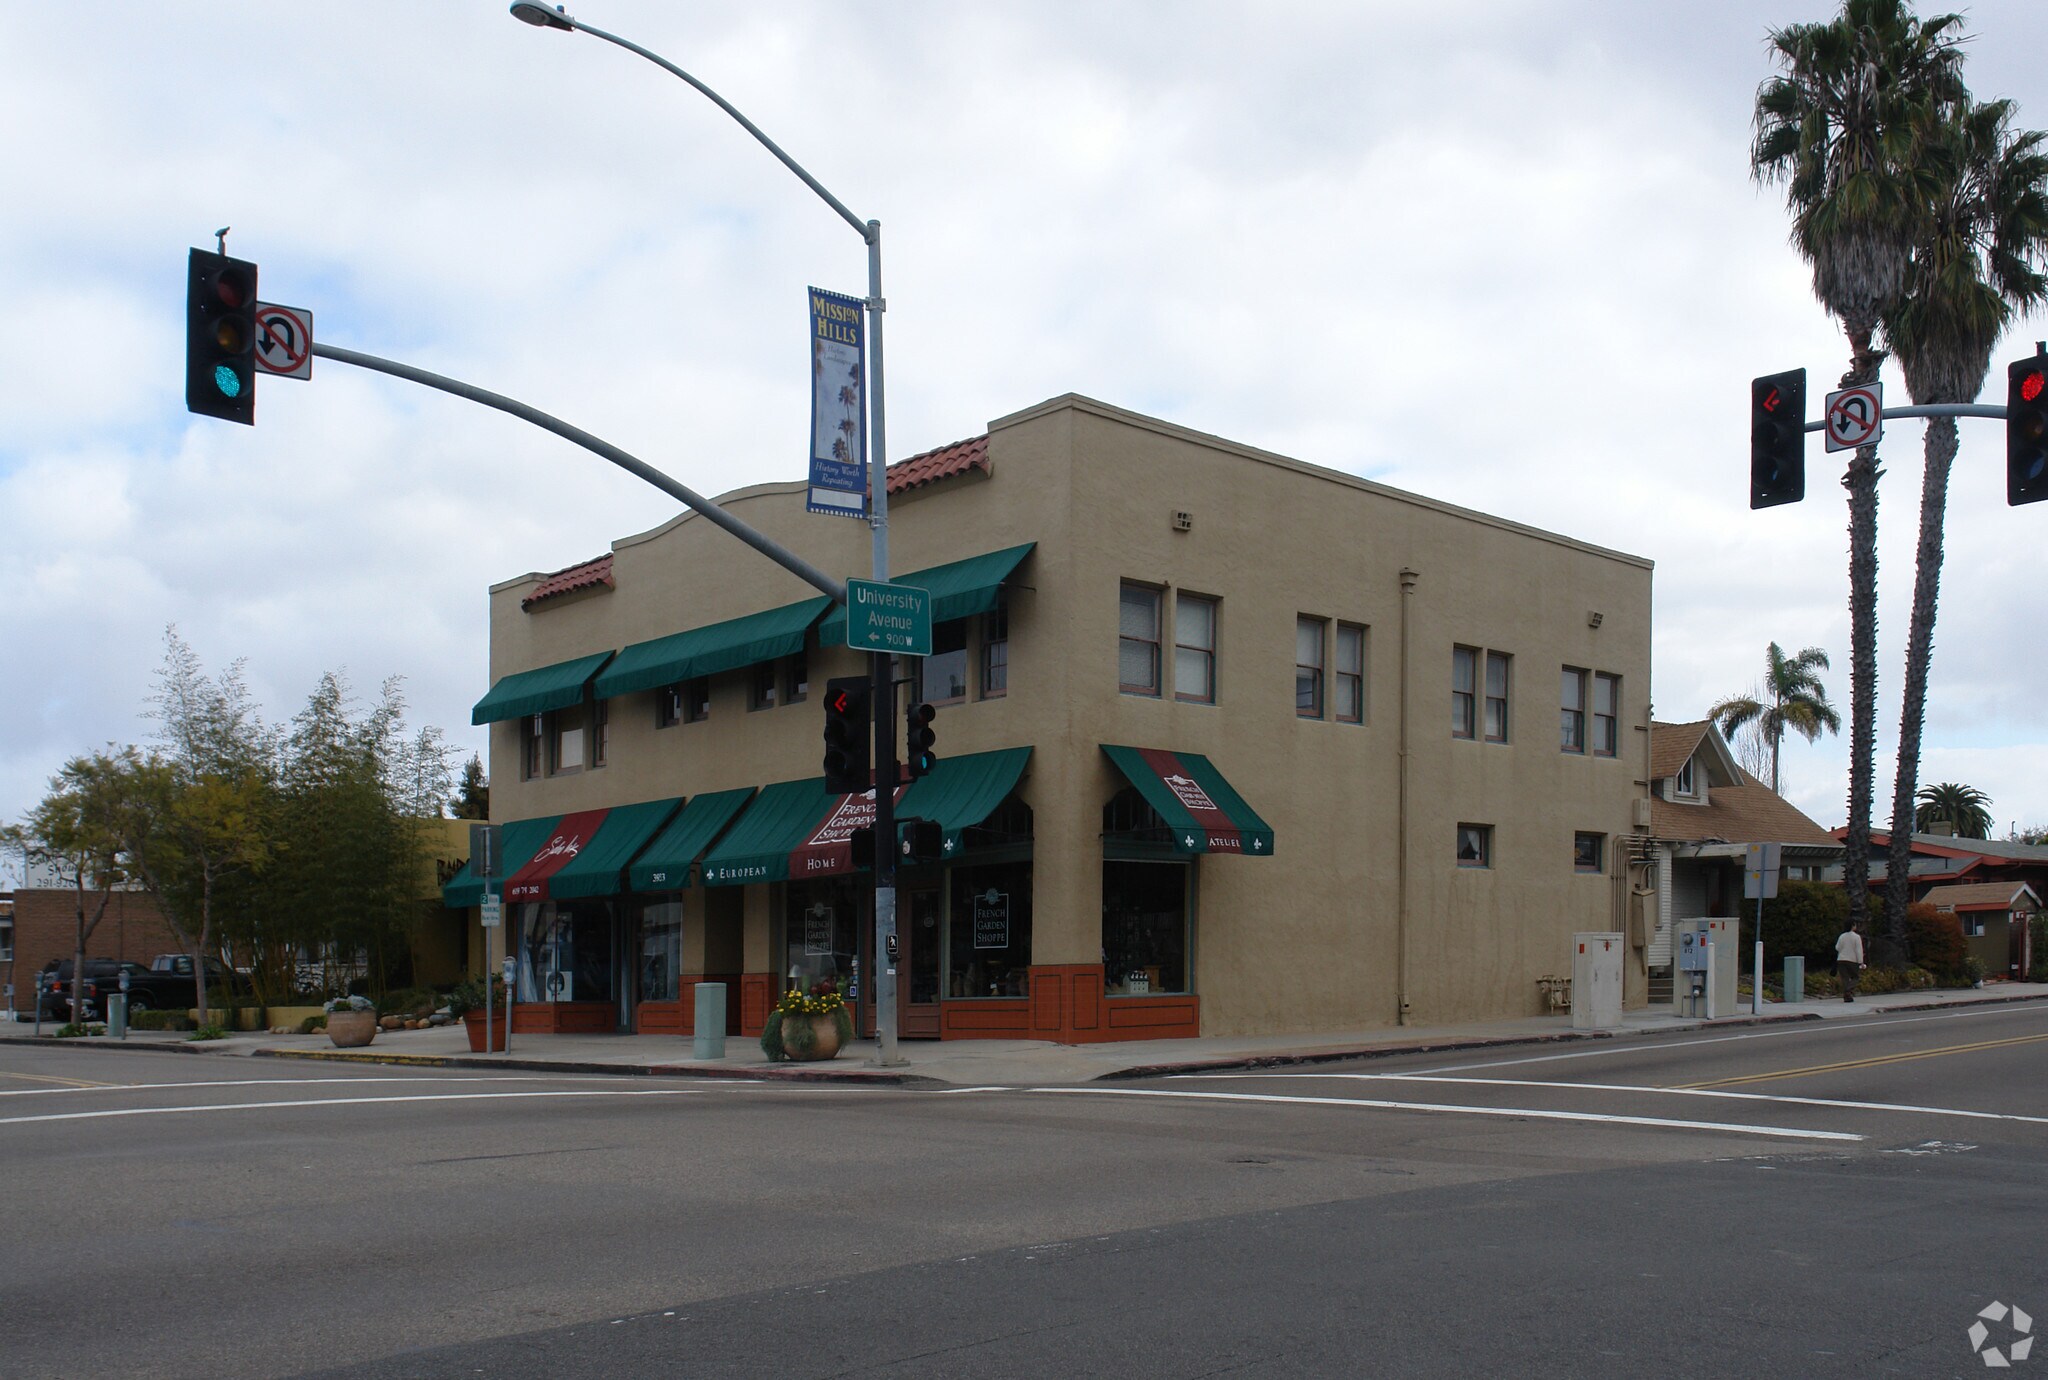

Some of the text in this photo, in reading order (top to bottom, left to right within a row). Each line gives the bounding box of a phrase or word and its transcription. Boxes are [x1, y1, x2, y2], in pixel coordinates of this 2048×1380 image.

[813, 296, 859, 325] MISSION
[817, 317, 857, 344] HILLS
[857, 587, 922, 614] University
[868, 610, 912, 630] Avenue
[840, 804, 876, 815] FRENC
[807, 858, 835, 870] HOME
[720, 866, 767, 879] EUROPEAN
[977, 908, 1006, 918] FRENCH
[977, 921, 1006, 930] GARDEN
[977, 932, 1006, 943] SHOPPE
